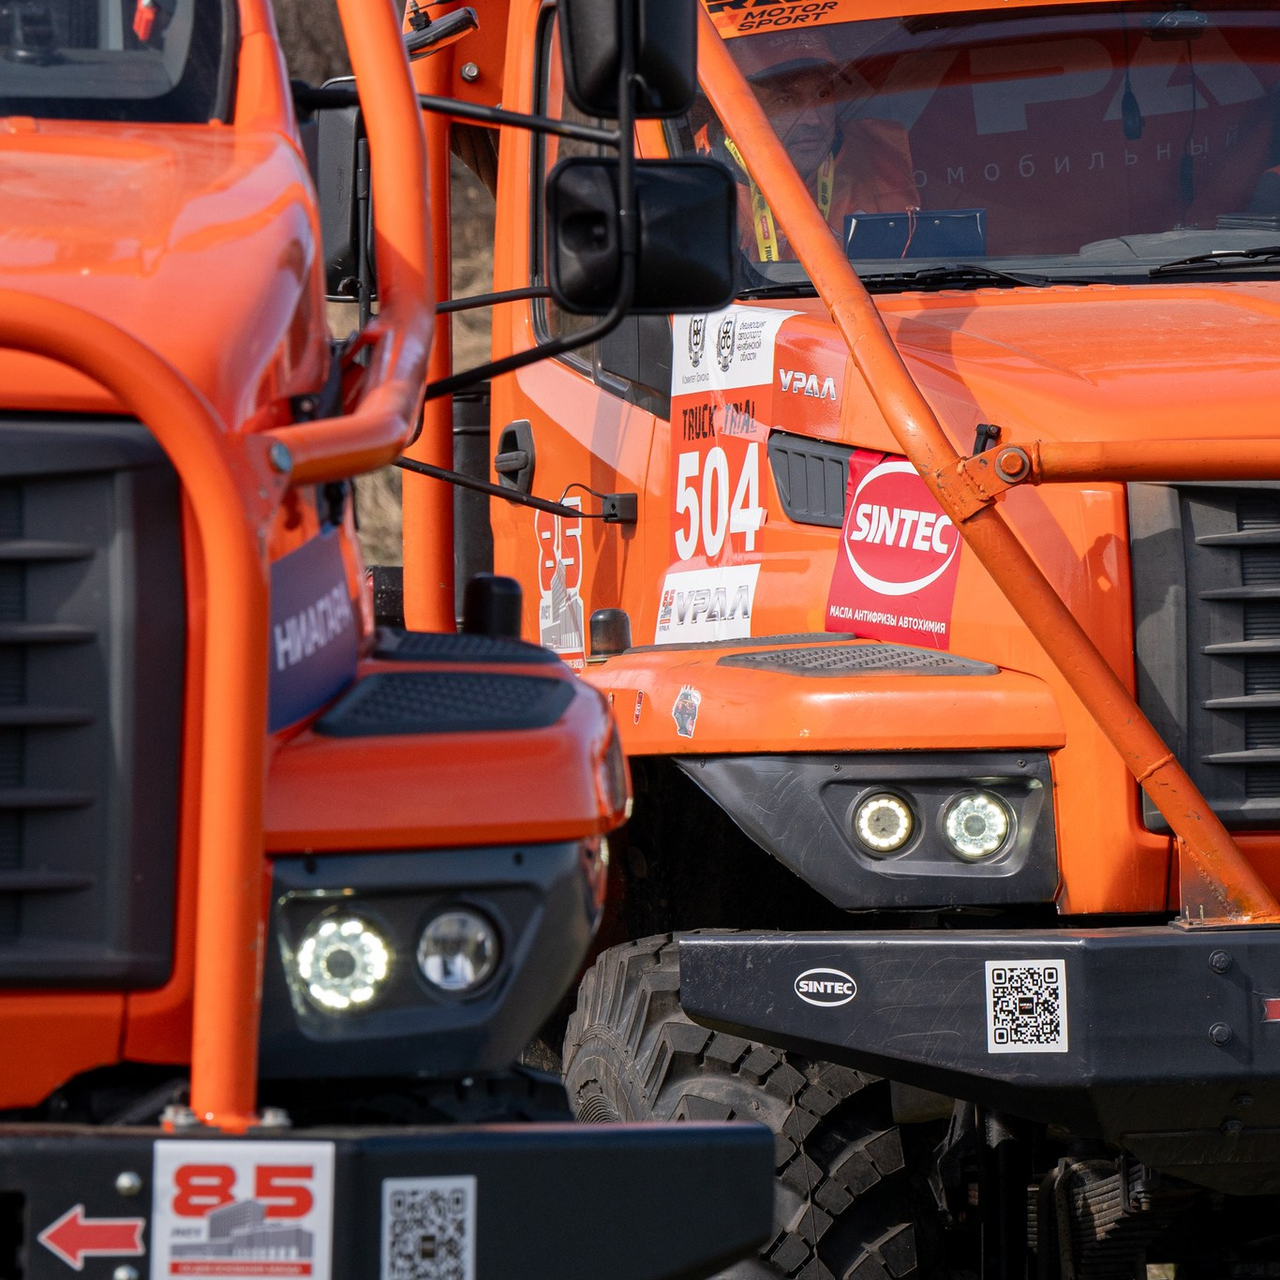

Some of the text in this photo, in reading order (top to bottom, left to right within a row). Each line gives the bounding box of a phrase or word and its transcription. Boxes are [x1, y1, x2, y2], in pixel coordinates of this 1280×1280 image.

[738, 12, 828, 31] SPORT
[743, 2, 838, 21] MOTOR
[779, 369, 837, 401] УРАЛ
[682, 399, 757, 441] TRUCK TRIAL
[675, 442, 764, 562] 504
[535, 496, 582, 593] 85
[850, 503, 953, 555] SINTEC
[677, 585, 750, 626] УРАЛ
[829, 605, 946, 634] МАСЛА АНТИФРИЗЫ АВТОХИМИЯ
[799, 980, 853, 995] SINTEC
[171, 1163, 315, 1220] 85
